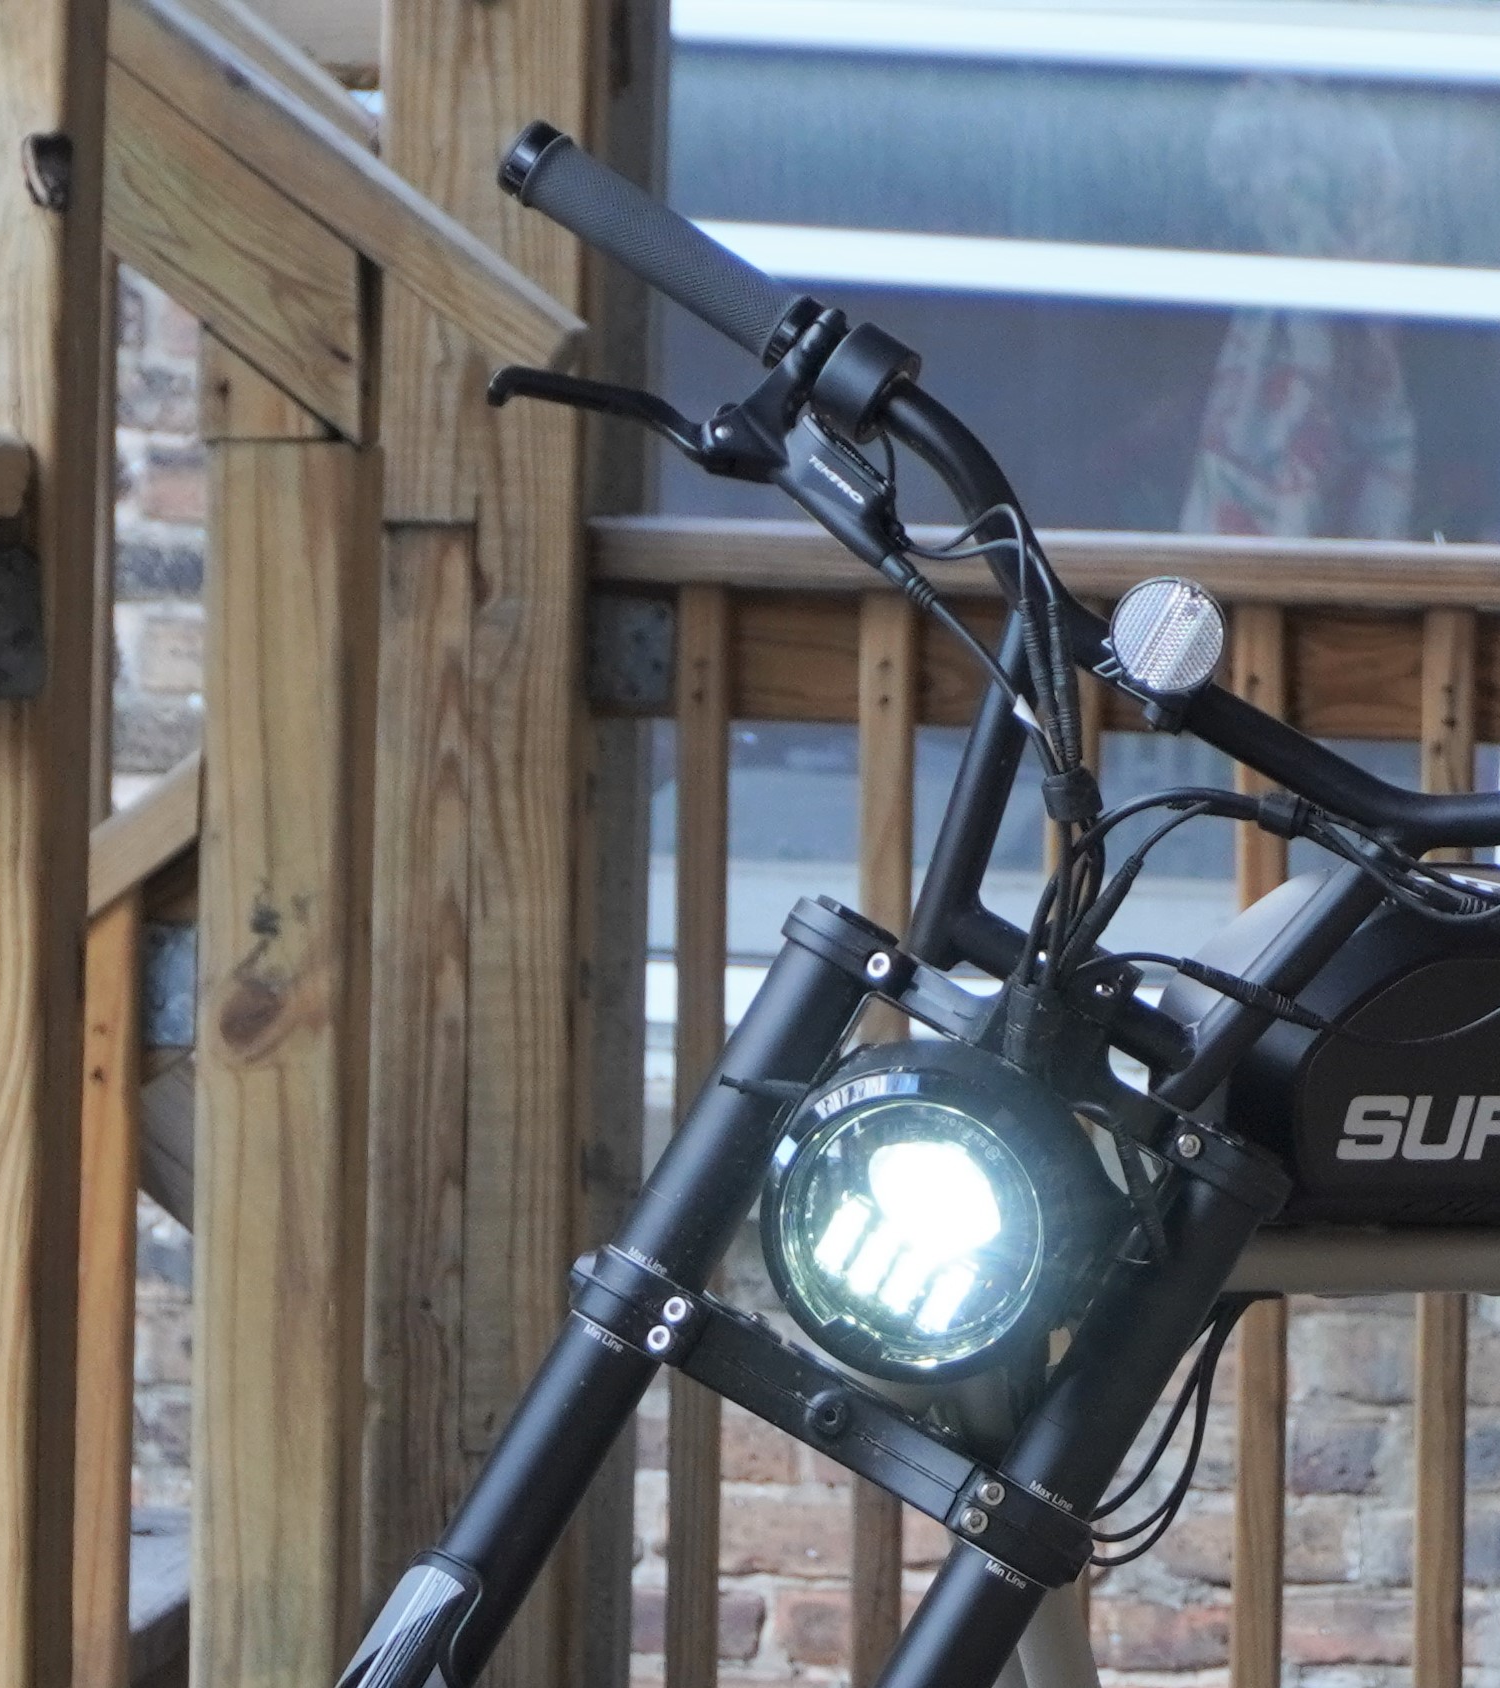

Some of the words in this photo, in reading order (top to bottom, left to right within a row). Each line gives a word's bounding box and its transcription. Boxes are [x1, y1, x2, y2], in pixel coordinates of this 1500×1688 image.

[809, 454, 865, 504] TEKTRO
[583, 1323, 602, 1340] Min
[601, 1333, 624, 1353] Line
[1029, 1480, 1052, 1500] Max
[1051, 1493, 1074, 1511] Line
[985, 1559, 1005, 1577] Min
[1005, 1571, 1027, 1589] Line
